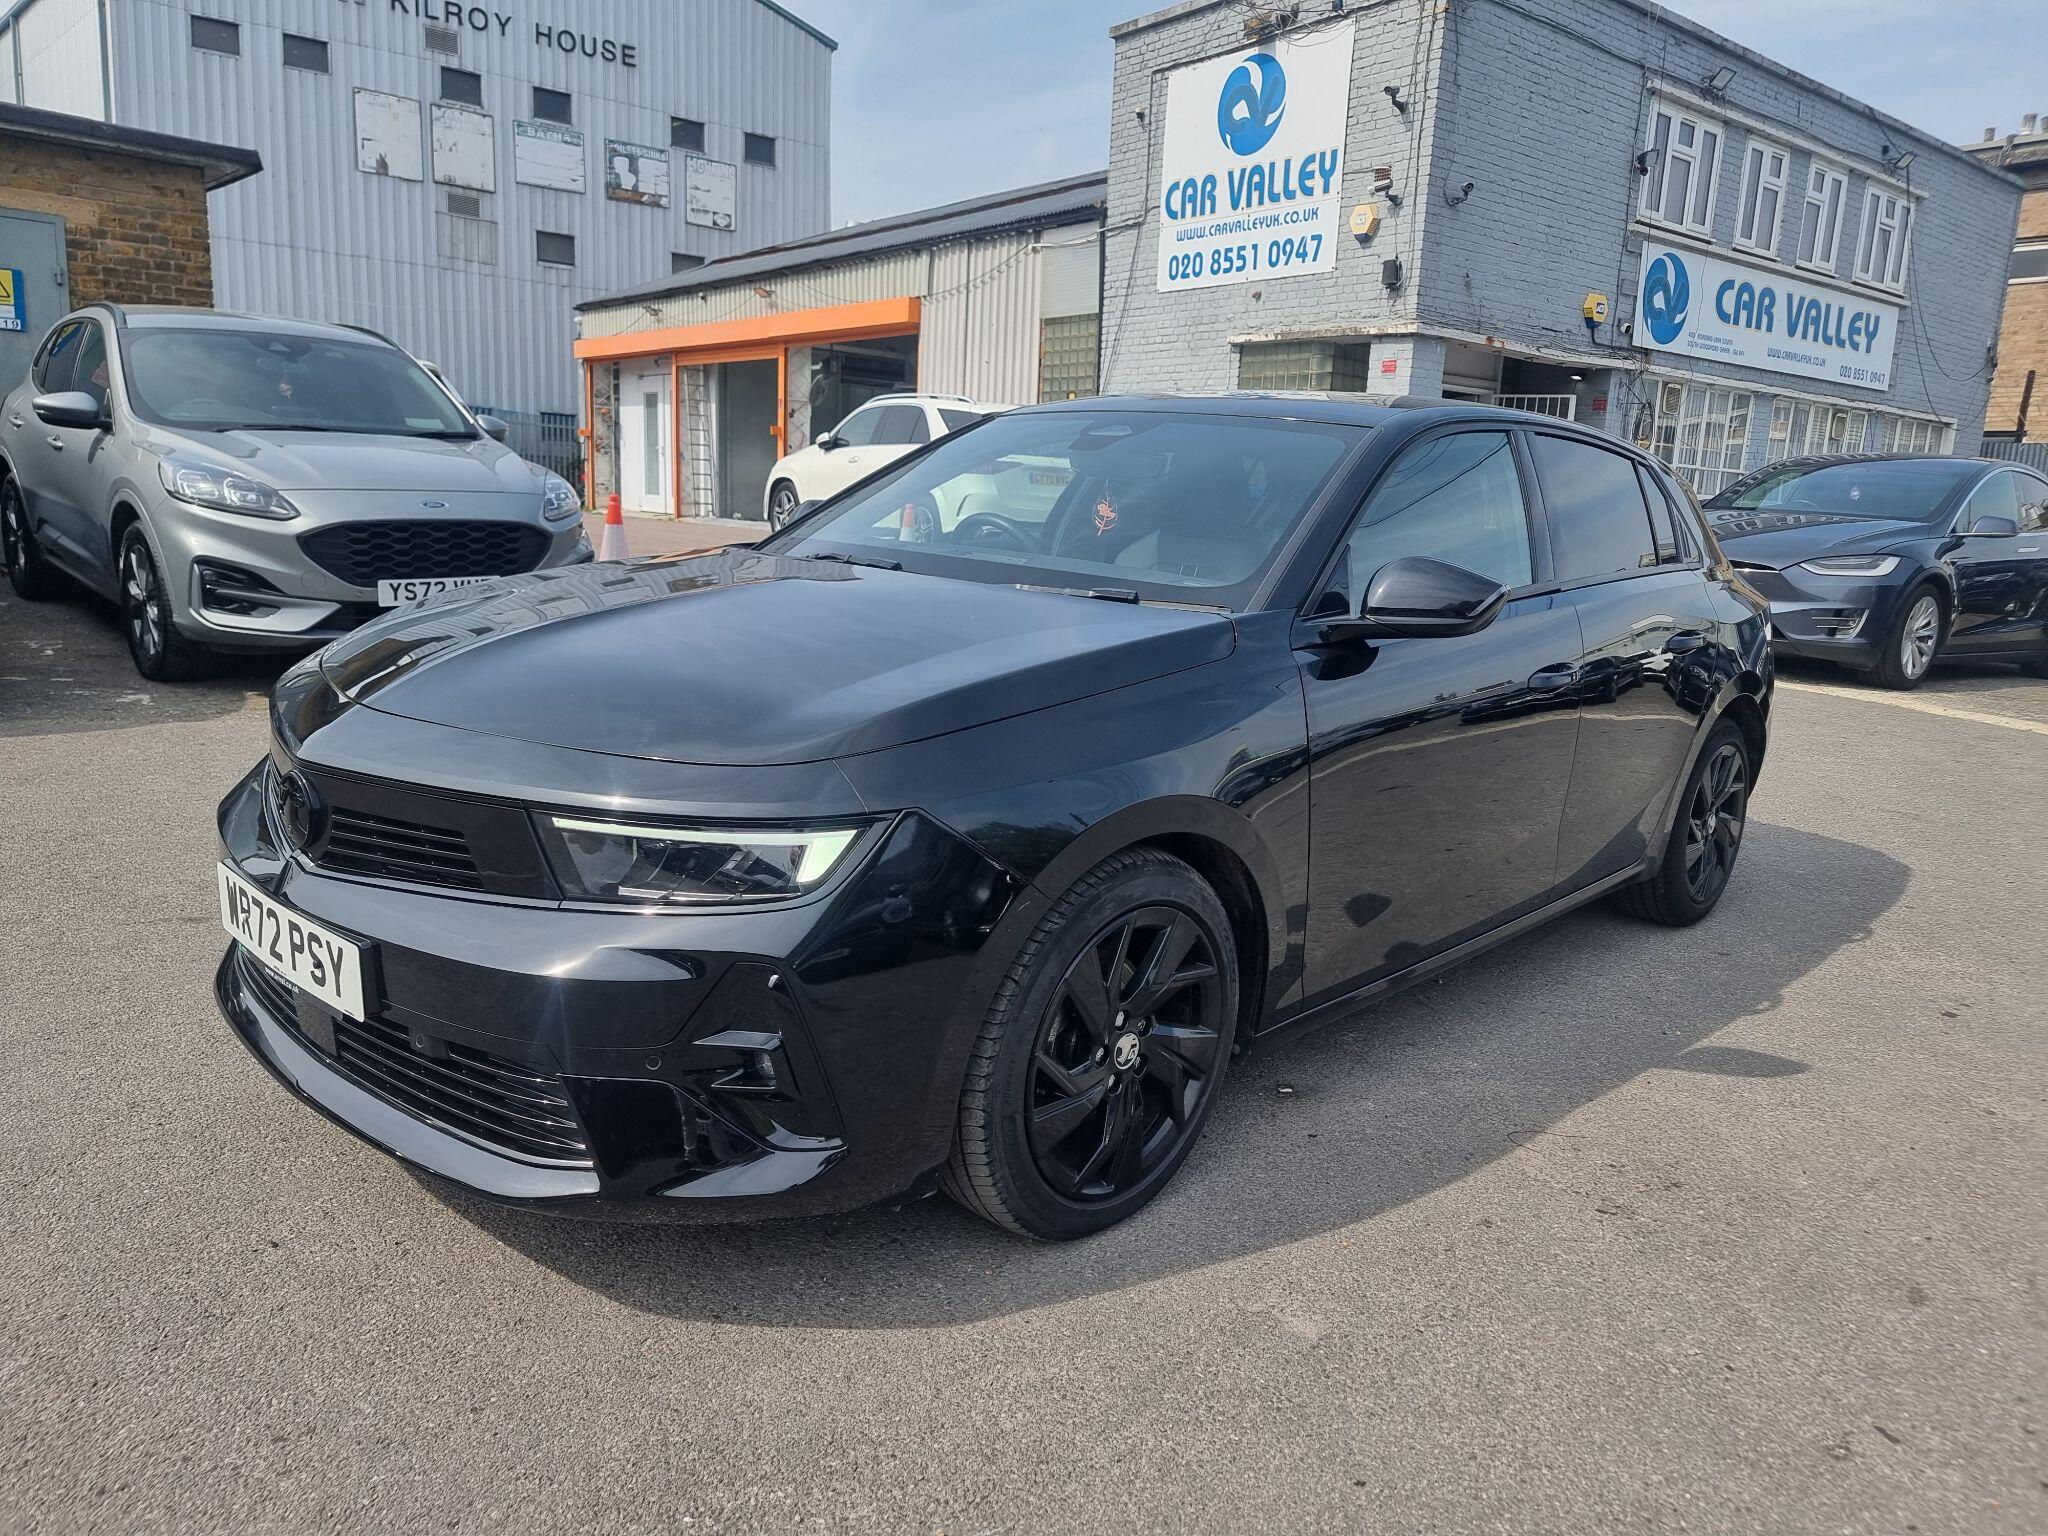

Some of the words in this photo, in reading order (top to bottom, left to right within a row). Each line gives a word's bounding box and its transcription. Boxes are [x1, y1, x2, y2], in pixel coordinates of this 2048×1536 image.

[390, 0, 512, 36] KILROY
[535, 22, 637, 67] HOUSE
[1165, 174, 1217, 220] CAR
[1227, 149, 1338, 211] VALLEY
[1168, 252, 1203, 281] 020
[1210, 243, 1259, 276] 8551
[1268, 233, 1323, 268] 0947
[1176, 207, 1319, 242] WWW.CARVALLEYUK.CO.UK
[1716, 279, 1776, 333] CAR
[1786, 292, 1880, 354] VALLEY
[1840, 365, 1851, 378] 020
[1853, 367, 1868, 381] 8551
[1869, 371, 1885, 385] 0947
[225, 875, 284, 963] WR72
[288, 919, 343, 998] PSY
